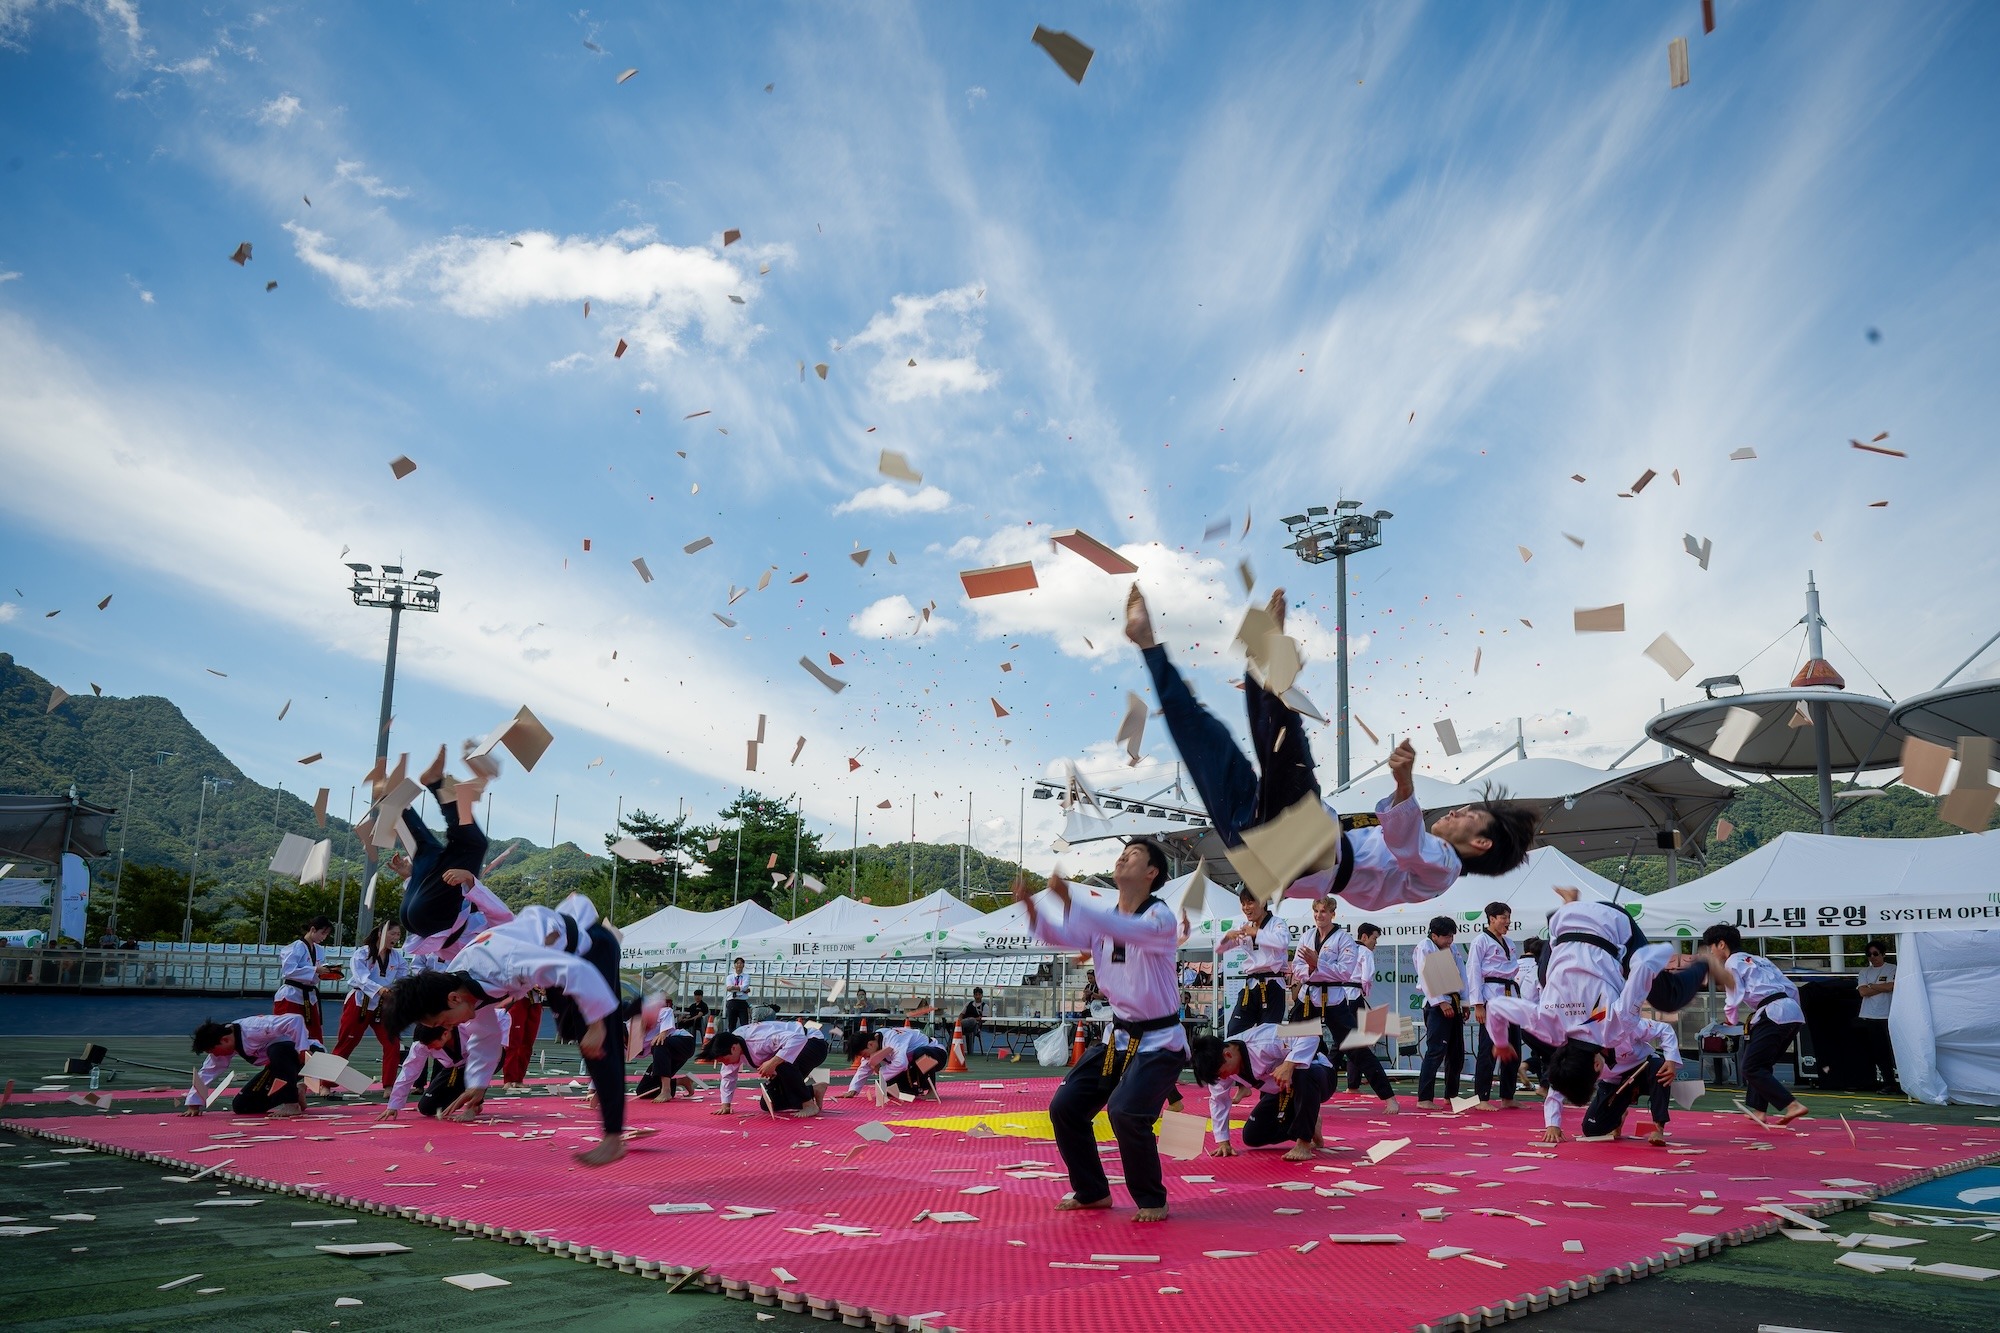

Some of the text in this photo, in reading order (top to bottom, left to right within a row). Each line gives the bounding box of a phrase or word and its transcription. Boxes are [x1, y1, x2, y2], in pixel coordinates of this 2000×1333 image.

[1736, 905, 1867, 928] 시스템 운영
[1879, 907, 1952, 921] SYSTEM
[822, 943, 857, 952] FEED ZONE
[983, 936, 1032, 950] 운영본부
[665, 947, 688, 956] STATION
[792, 942, 820, 956] 피드존
[1544, 1002, 1586, 1010] TAEKWONDO
[1564, 1009, 1587, 1017] WORLD
